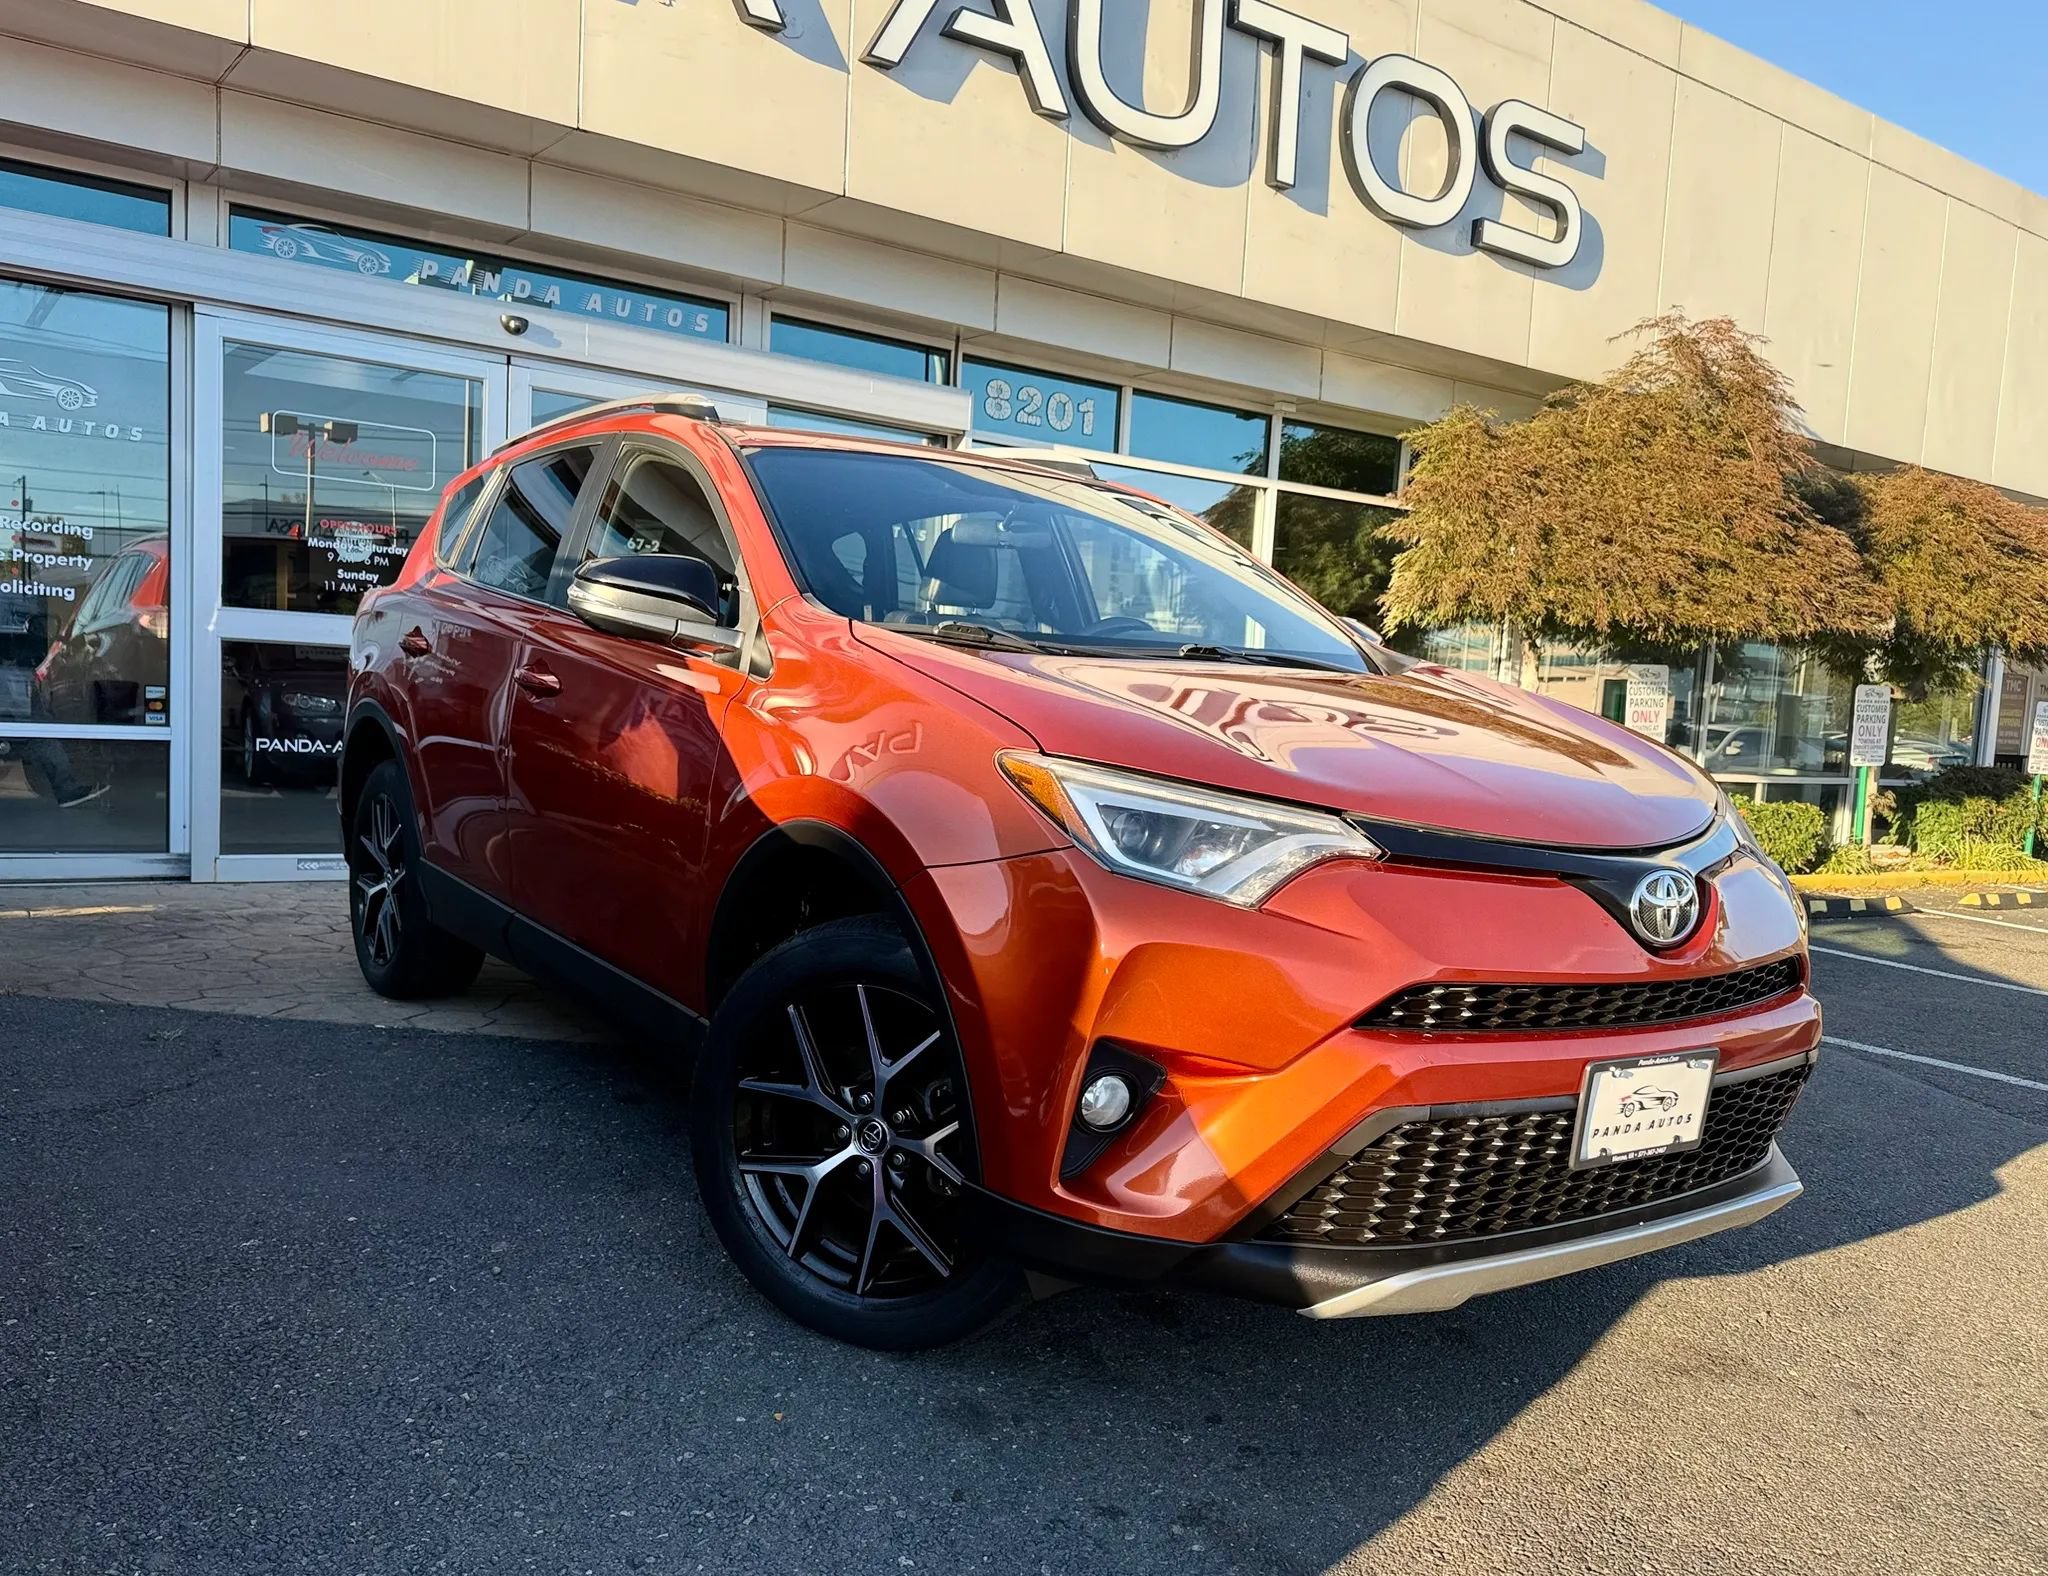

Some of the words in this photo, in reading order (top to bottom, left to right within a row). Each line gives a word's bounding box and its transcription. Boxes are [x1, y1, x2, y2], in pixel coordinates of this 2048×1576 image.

[858, 0, 1585, 269] AUTOS
[419, 258, 561, 305] PANDA
[586, 293, 710, 333] AUTOS
[984, 379, 1095, 436] 8201
[32, 415, 143, 441] AUTOS
[0, 516, 94, 539] Recording
[320, 519, 353, 531] OPEN
[359, 522, 398, 535] HOURS
[12, 549, 93, 571] Property
[327, 552, 335, 562] 9
[373, 556, 389, 567] PM
[337, 569, 379, 584] Sunday
[324, 580, 336, 591] 11
[340, 583, 357, 592] AM
[1629, 686, 1666, 696] CUSTOMER
[1630, 697, 1664, 708] PARKING
[1856, 704, 1888, 713] CUSTOMER
[1632, 710, 1660, 723] ONLY
[1856, 714, 1886, 724] PARKING
[1858, 725, 1883, 737] ONLY
[1592, 1121, 1641, 1139] PANDA
[1648, 1113, 1692, 1130] AUTOS
